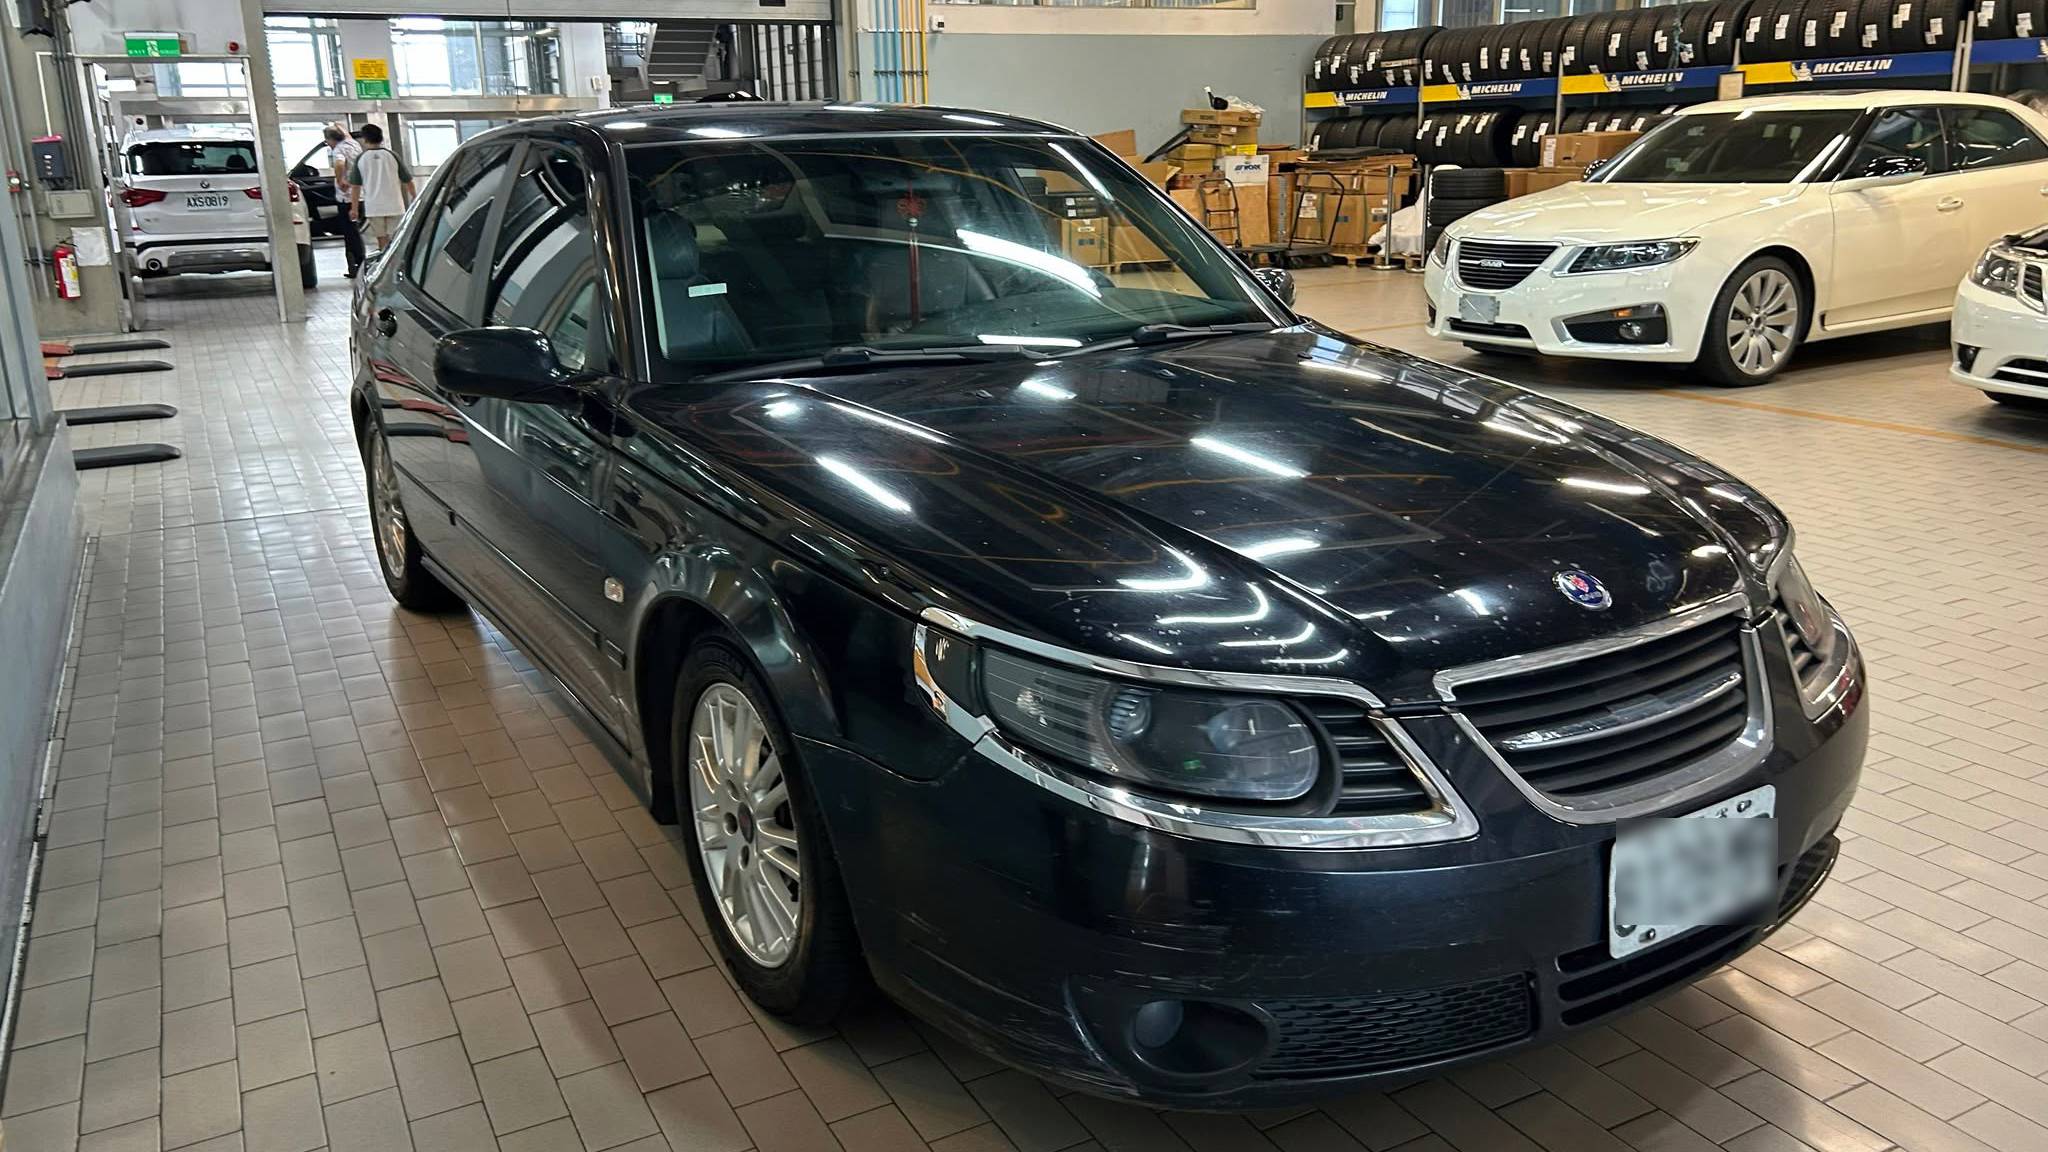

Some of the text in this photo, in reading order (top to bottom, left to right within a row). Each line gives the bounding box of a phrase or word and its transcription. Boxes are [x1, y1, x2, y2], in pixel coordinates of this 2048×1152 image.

[1813, 59, 1892, 73] MICHELIN
[1471, 83, 1522, 94] MICHELIN
[1345, 91, 1387, 100] MICHELIN
